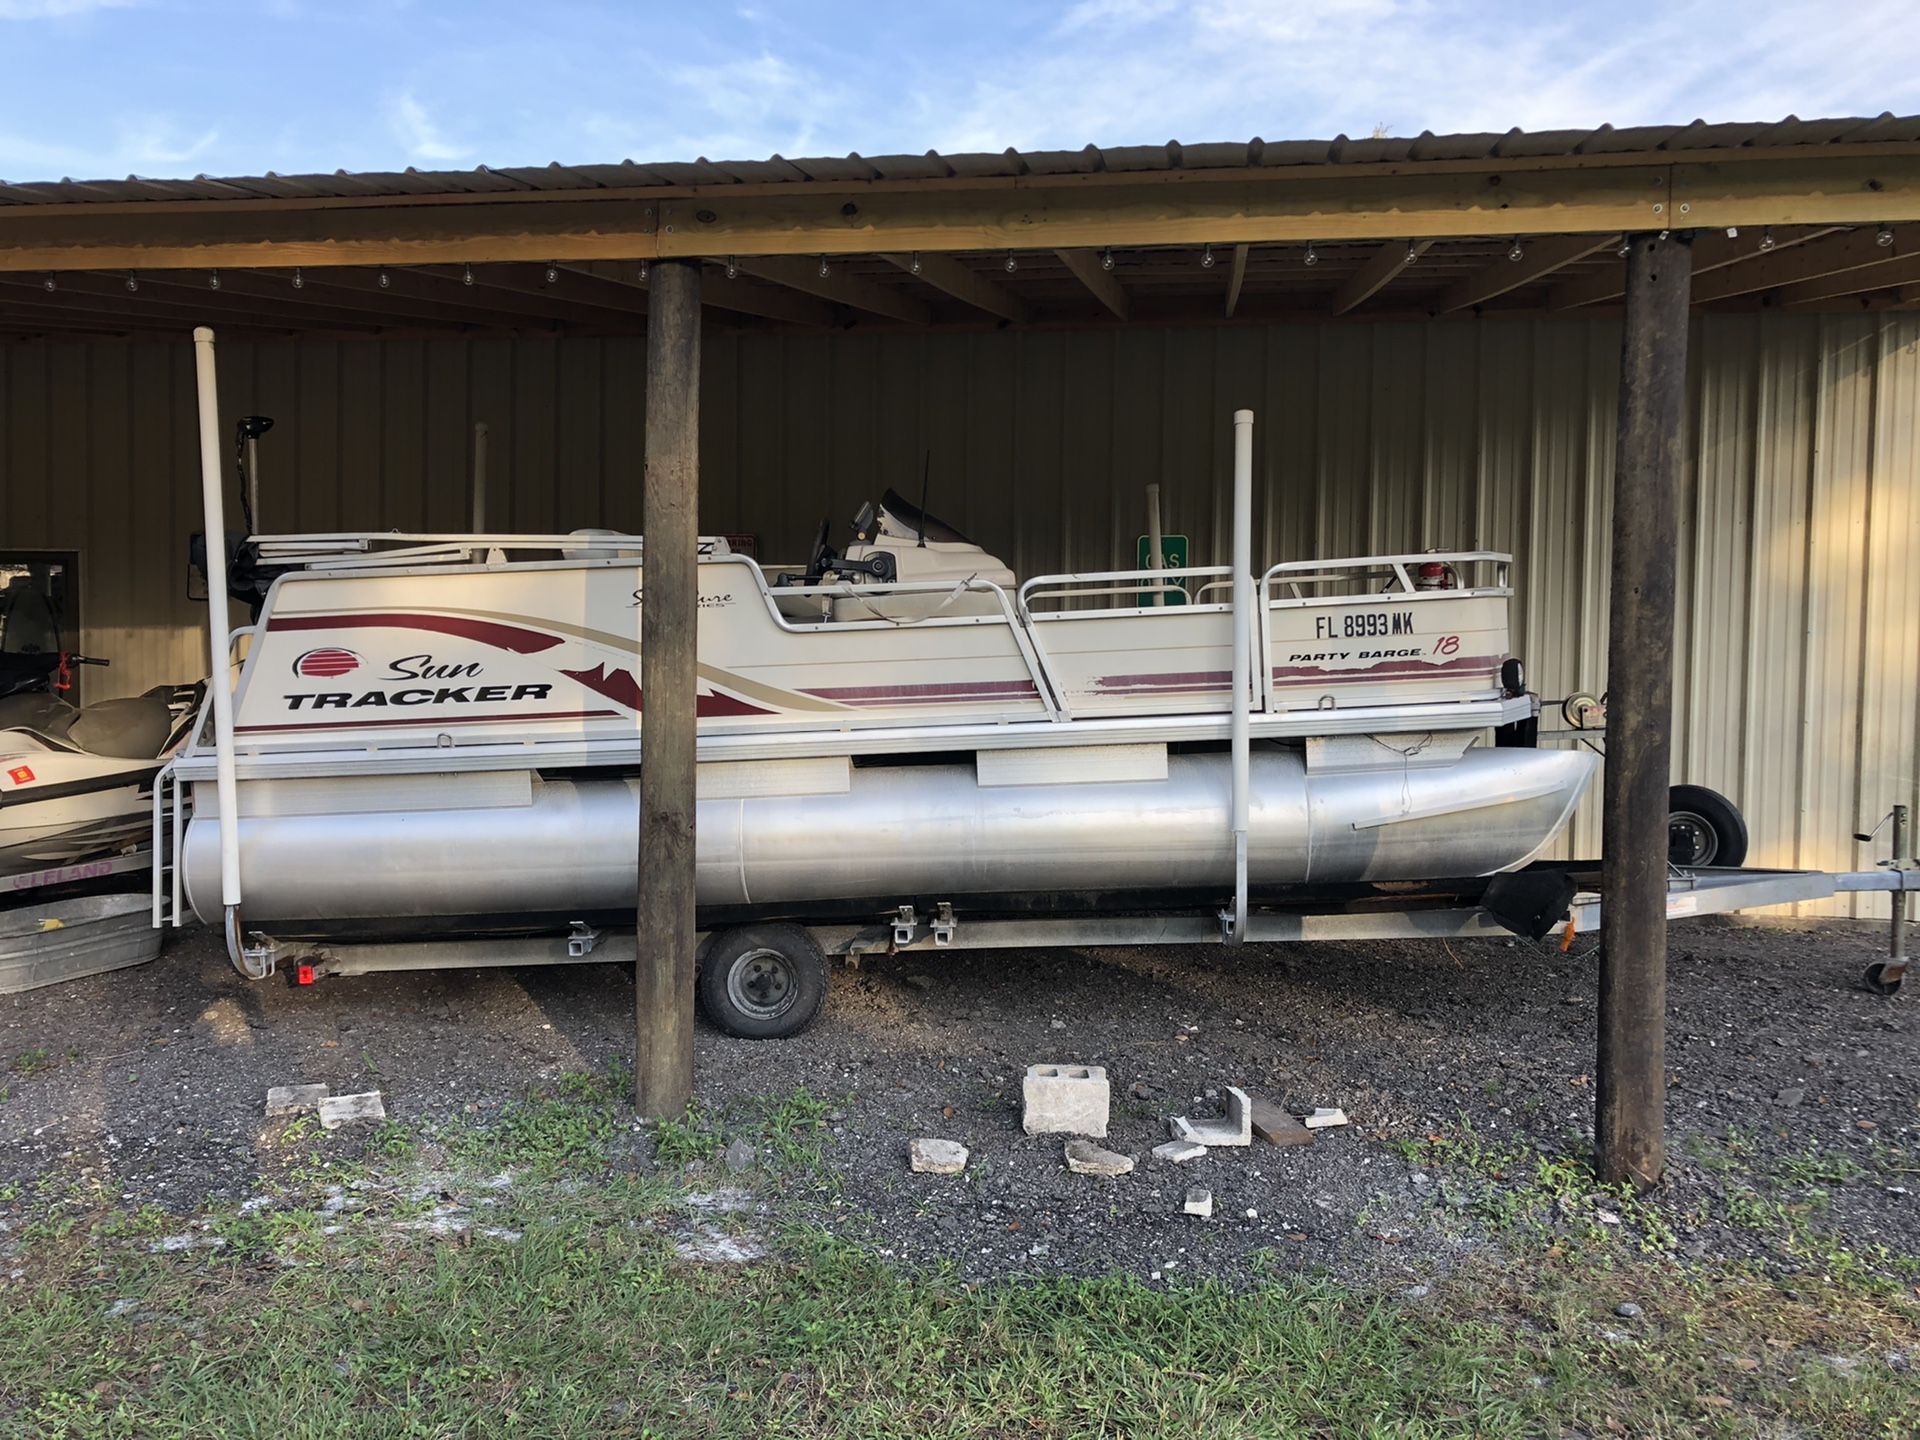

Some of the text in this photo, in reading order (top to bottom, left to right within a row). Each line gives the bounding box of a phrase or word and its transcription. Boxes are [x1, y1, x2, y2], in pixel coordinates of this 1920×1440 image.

[1316, 612, 1414, 639] FL 8993 MK
[1289, 635, 1460, 662] PARTY BARGE 18
[377, 654, 484, 681] Sun
[282, 683, 553, 710] TRACKER
